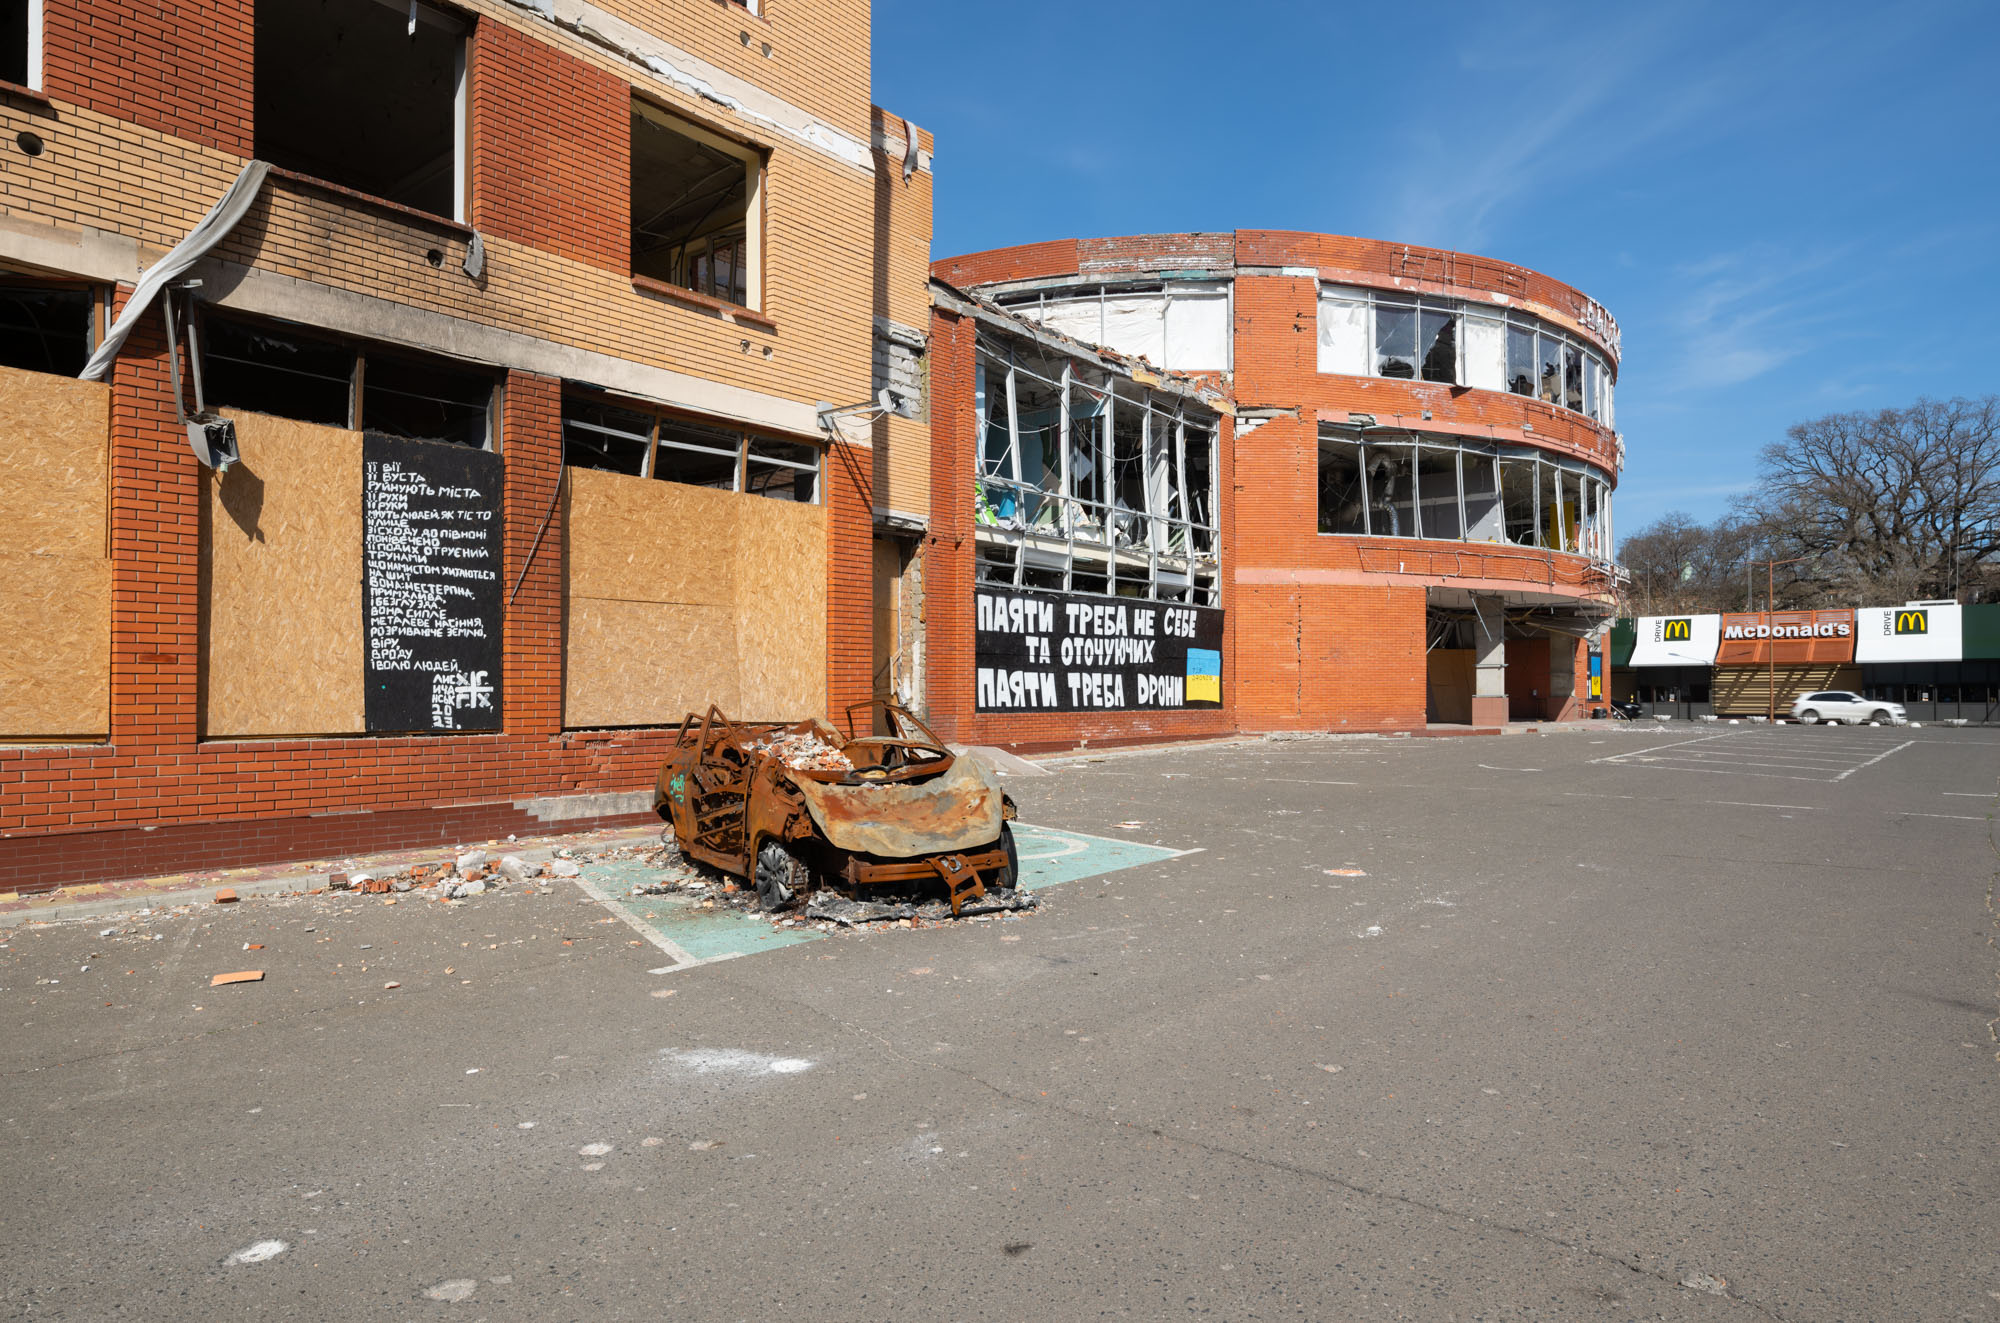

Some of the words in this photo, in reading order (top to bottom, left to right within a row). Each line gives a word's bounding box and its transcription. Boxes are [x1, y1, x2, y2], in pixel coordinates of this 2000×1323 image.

[382, 472, 426, 483] ВУСТА
[368, 480, 435, 496] РУЙНУЮТЬ
[378, 492, 408, 503] РУХИ
[377, 501, 408, 511] РУКИ
[441, 510, 454, 520] ЯК
[376, 518, 410, 528] ЛИЦЕ
[421, 528, 438, 538] ДО
[377, 543, 419, 555] ПОДИХ
[367, 550, 428, 565] ТРУНАМИ
[368, 567, 384, 578] НА
[386, 570, 412, 582] ШИТ
[386, 561, 441, 576] НАМИСТОМ
[441, 565, 496, 580] ХИТАЮТЬСЯ
[370, 606, 404, 617] ВОНА
[405, 608, 448, 620] СИПЛЕ
[977, 594, 1053, 634] ПАЯТИ
[1065, 603, 1128, 637] ТРЕБА
[1134, 608, 1155, 636] НЕ
[1163, 607, 1198, 638] СЕБЕ
[370, 615, 431, 628] МЕТАЛЕВЕ
[1883, 609, 1892, 636] DRIVE
[446, 627, 488, 640] ЗЕМЛЮ,
[1654, 619, 1662, 643] DRIVE
[1724, 622, 1850, 639] McDonald's
[371, 649, 414, 661] ВРОДУ
[1025, 636, 1050, 664] ТА
[1061, 637, 1155, 666] ОТОЧУЮЧИХ
[376, 660, 411, 671] ВОЛЮ
[977, 668, 1057, 708] ПАЯТИ
[1067, 672, 1125, 708] ТРЕБА
